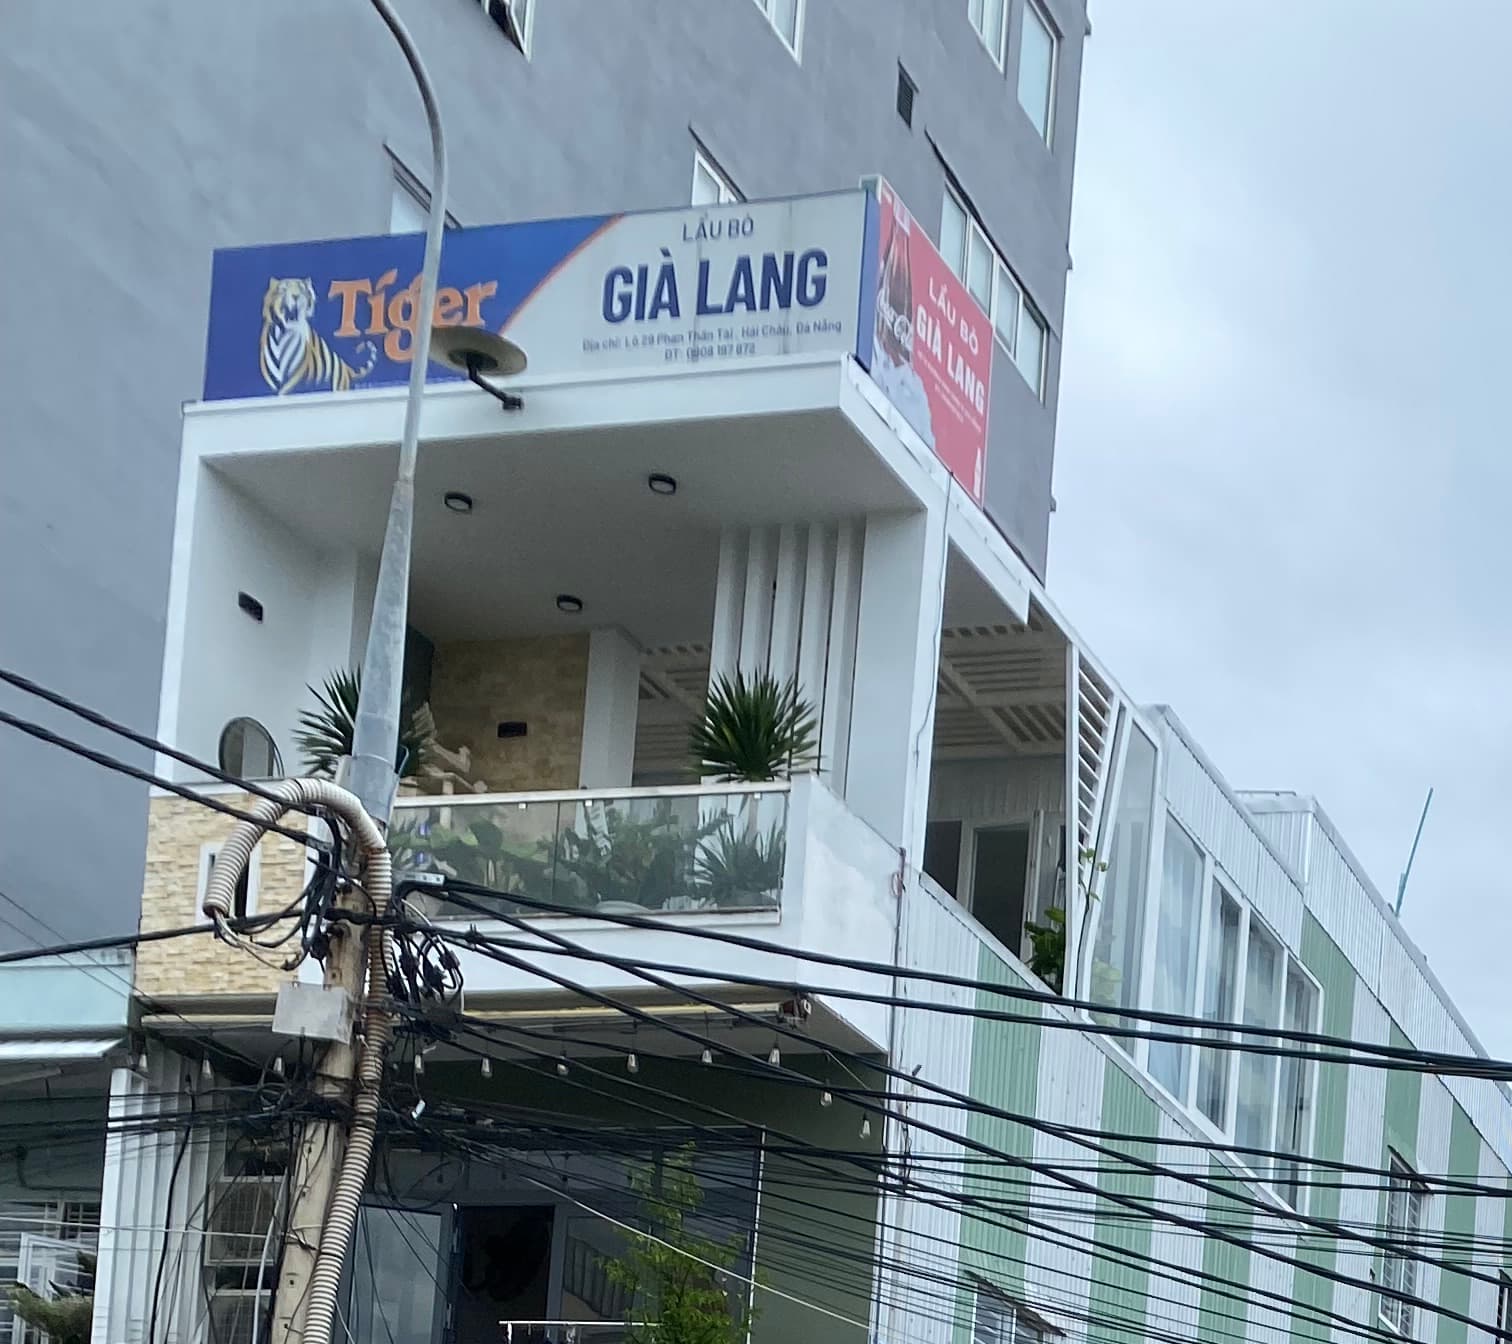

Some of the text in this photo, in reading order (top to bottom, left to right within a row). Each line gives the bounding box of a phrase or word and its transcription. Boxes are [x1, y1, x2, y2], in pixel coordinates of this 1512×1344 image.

[602, 246, 828, 323] GIÀ LANG
[947, 341, 985, 417] LANG
